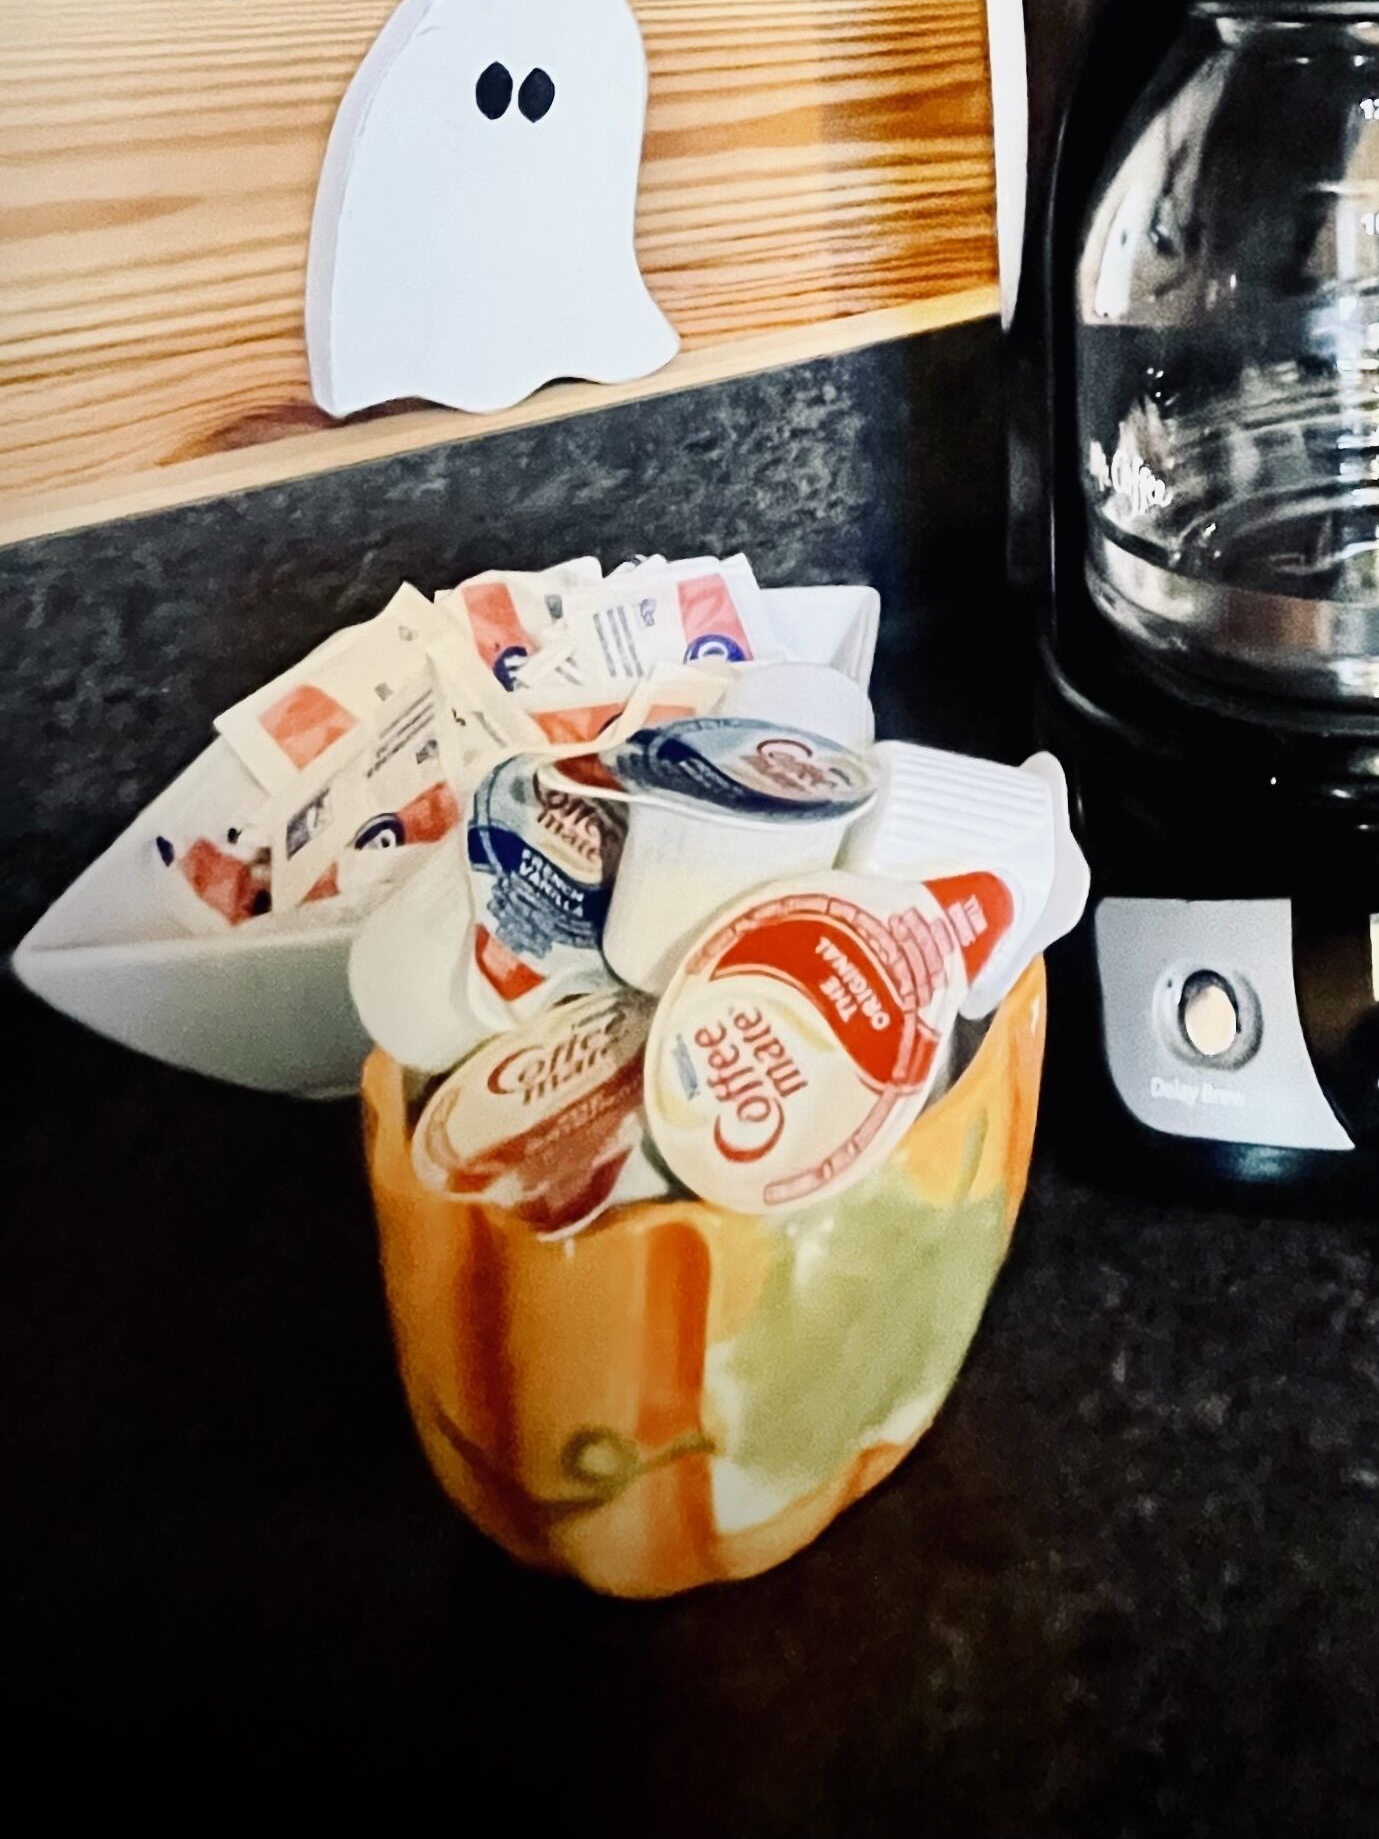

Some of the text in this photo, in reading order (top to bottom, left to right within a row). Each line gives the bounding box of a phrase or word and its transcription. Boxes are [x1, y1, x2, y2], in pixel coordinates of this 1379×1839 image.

[519, 861, 584, 918] VANILLA
[520, 848, 585, 902] FRENCH
[814, 935, 891, 1031] ORIGINAL
[818, 975, 858, 1024] THE
[695, 1020, 785, 1164] Coffee
